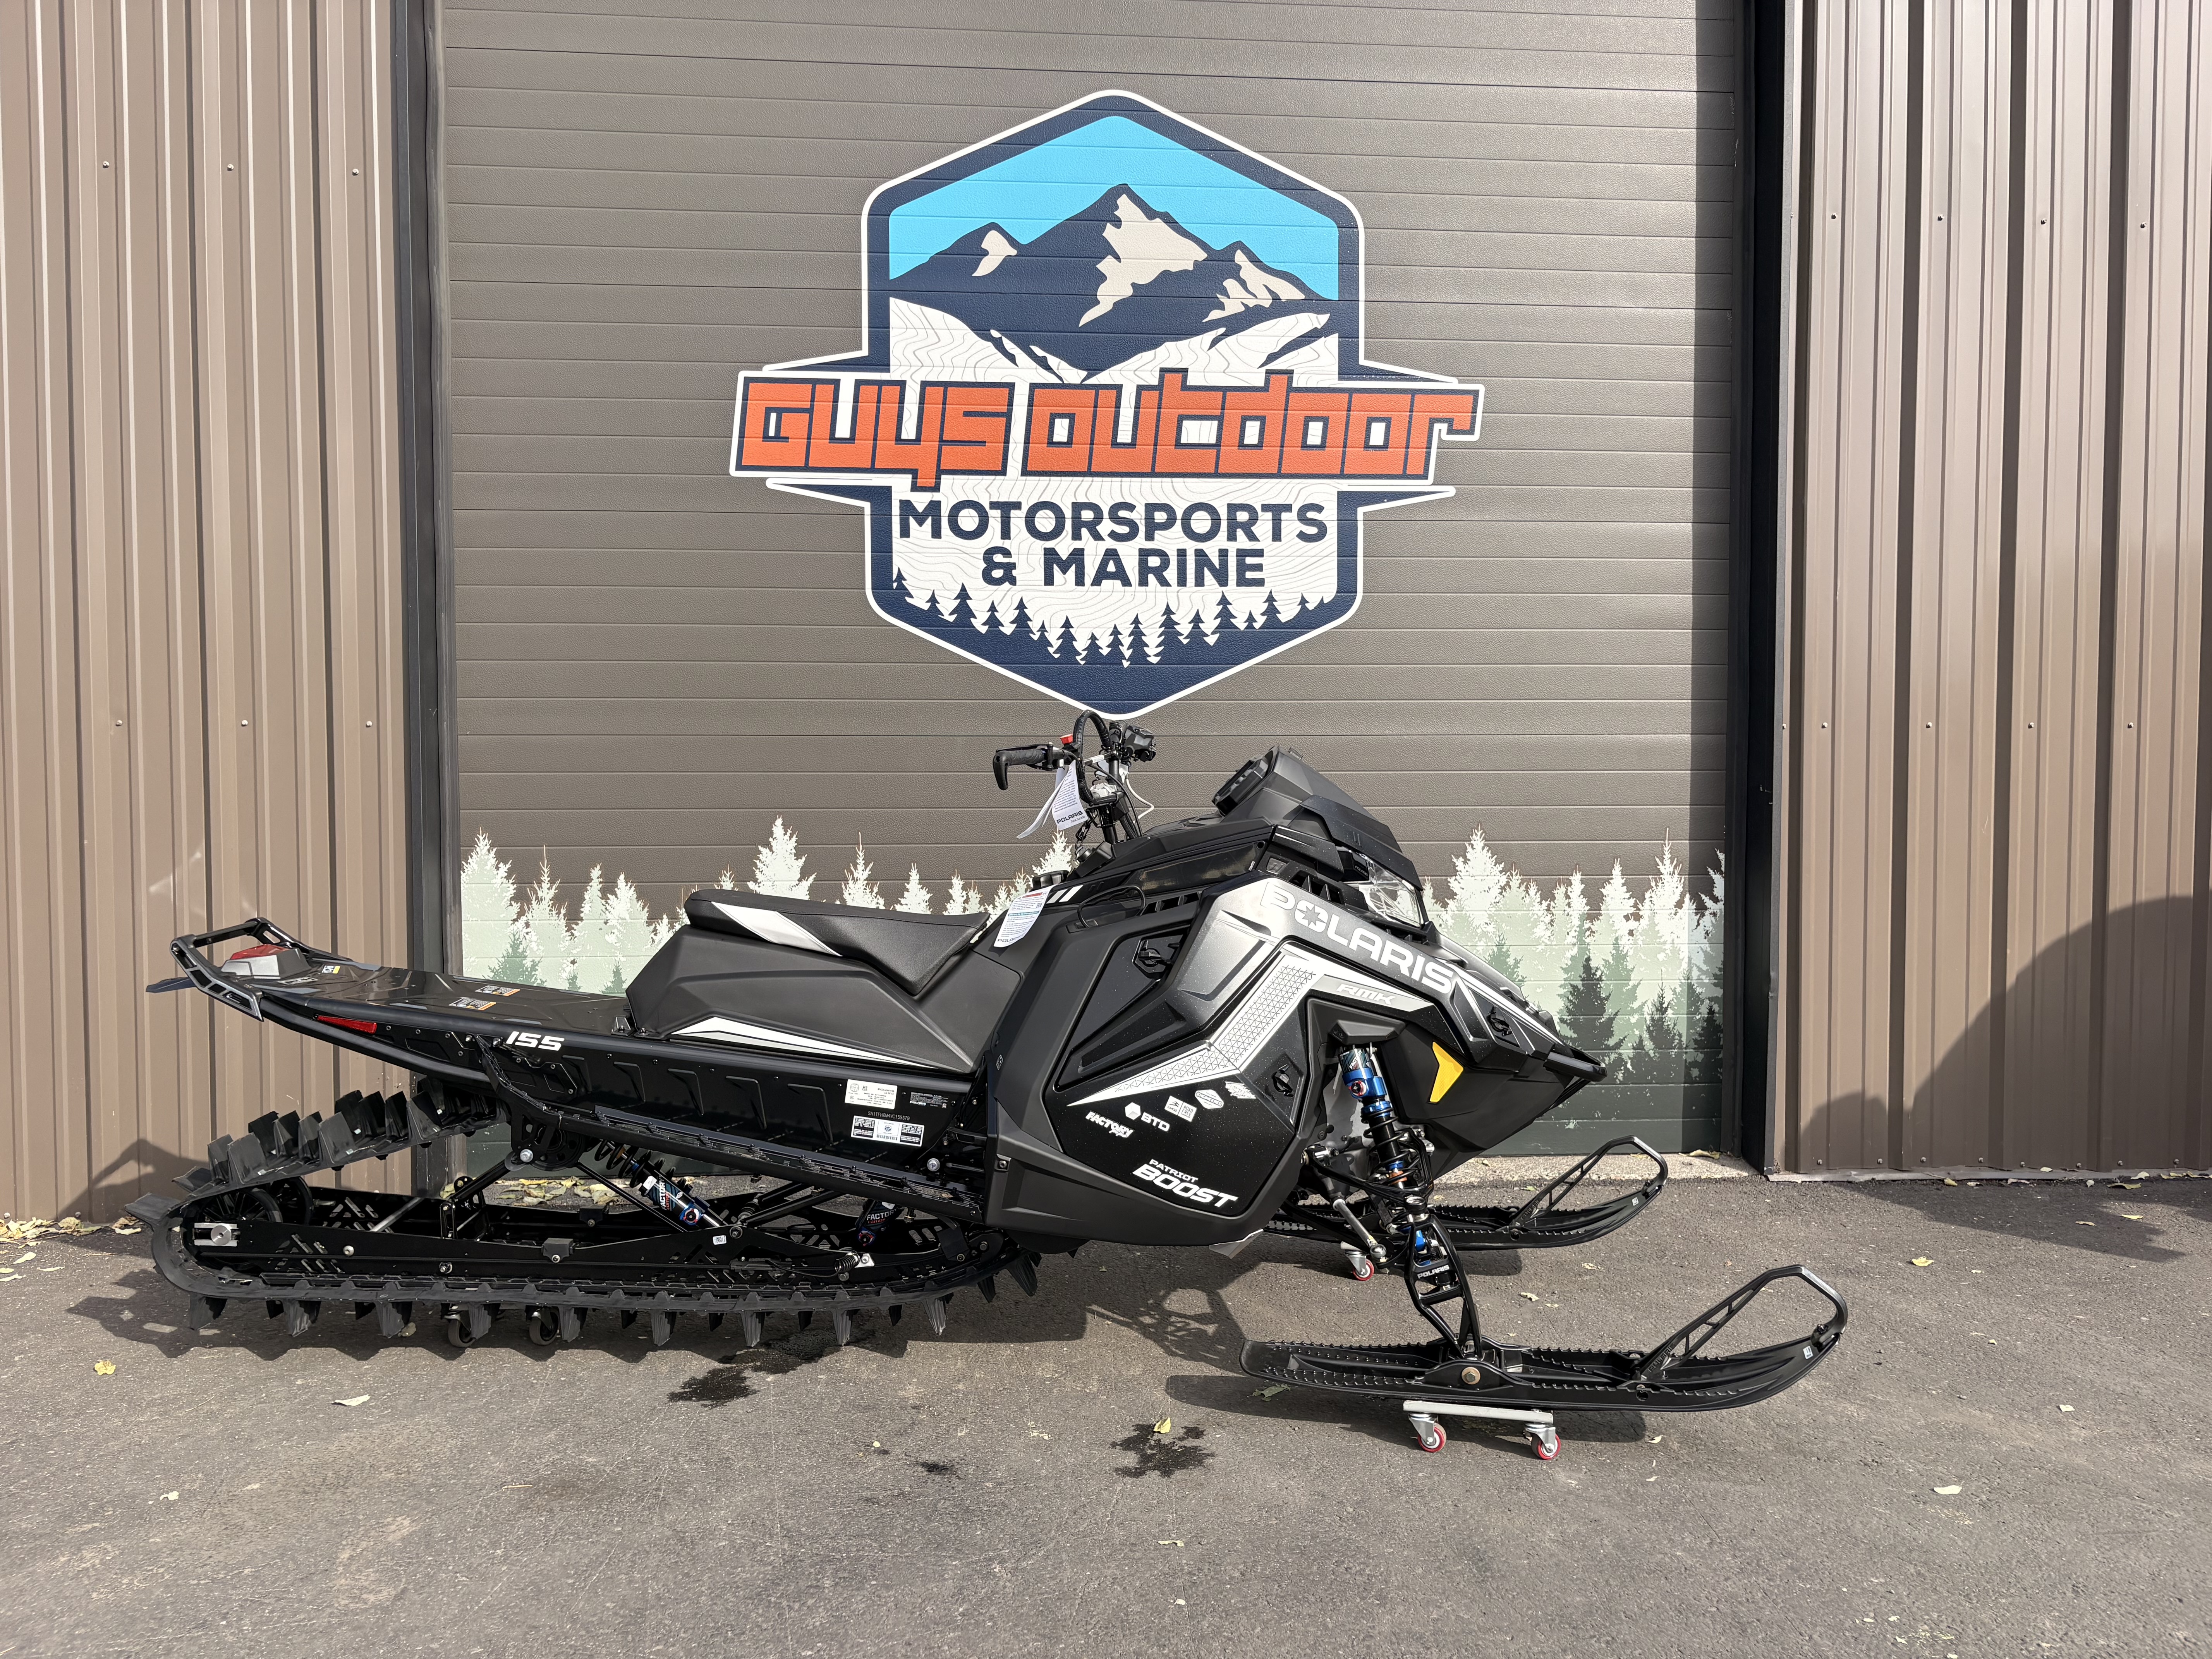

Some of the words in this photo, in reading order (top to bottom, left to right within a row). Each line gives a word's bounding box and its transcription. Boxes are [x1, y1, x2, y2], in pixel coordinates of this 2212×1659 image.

[899, 499, 1328, 543] MOTORSPORTS
[982, 546, 1017, 586] &
[1043, 547, 1265, 587] MARINE
[1056, 811, 1083, 824] POLARIS
[1260, 882, 1454, 994] POLARIS
[1336, 984, 1396, 1005] RMK
[506, 1031, 565, 1051] 155
[1085, 1111, 1134, 1137] FACTORY
[1141, 1112, 1170, 1132] BTD
[1149, 1159, 1199, 1183] PATRIOT
[1132, 1163, 1238, 1207] BOOST
[1417, 1264, 1450, 1279] POLARIS
